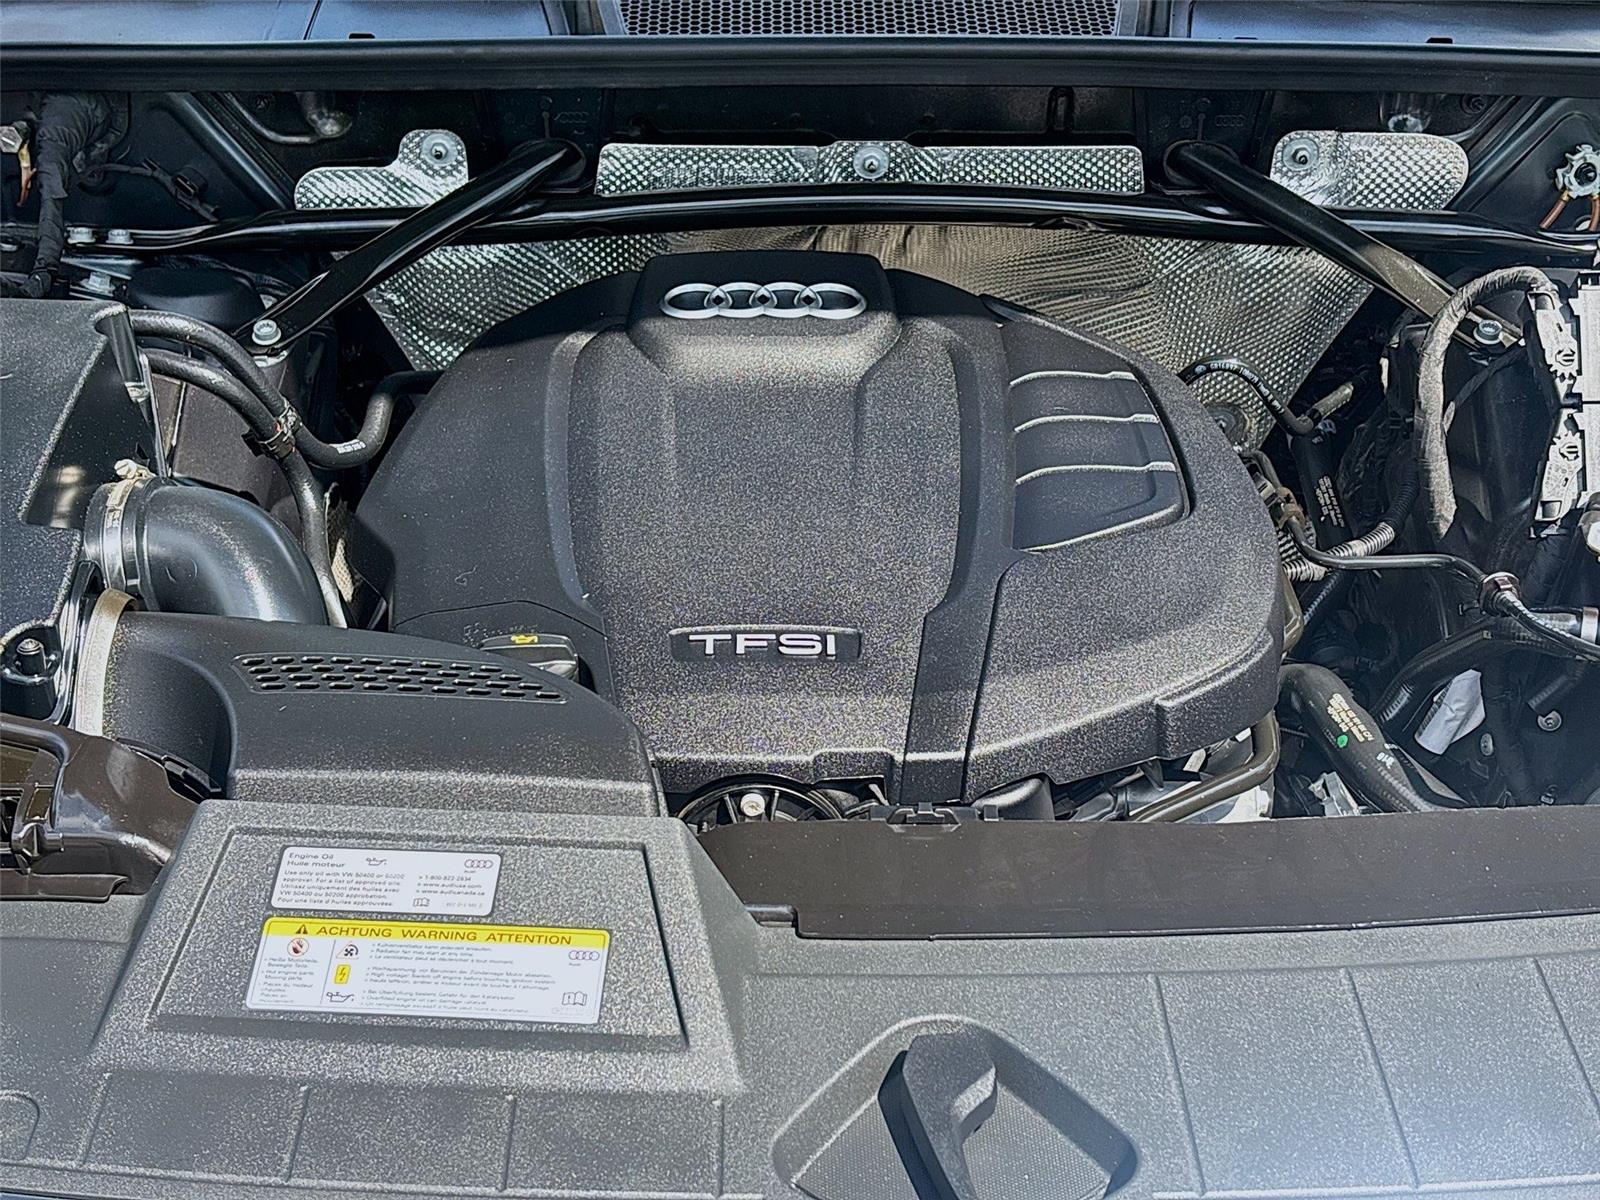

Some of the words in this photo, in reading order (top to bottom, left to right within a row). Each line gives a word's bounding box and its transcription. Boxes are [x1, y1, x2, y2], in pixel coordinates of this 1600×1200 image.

[688, 634, 836, 655] TFSI
[316, 926, 393, 938] ACHTUNG
[401, 929, 477, 941] WARNING
[485, 932, 572, 945] ATTENTION
